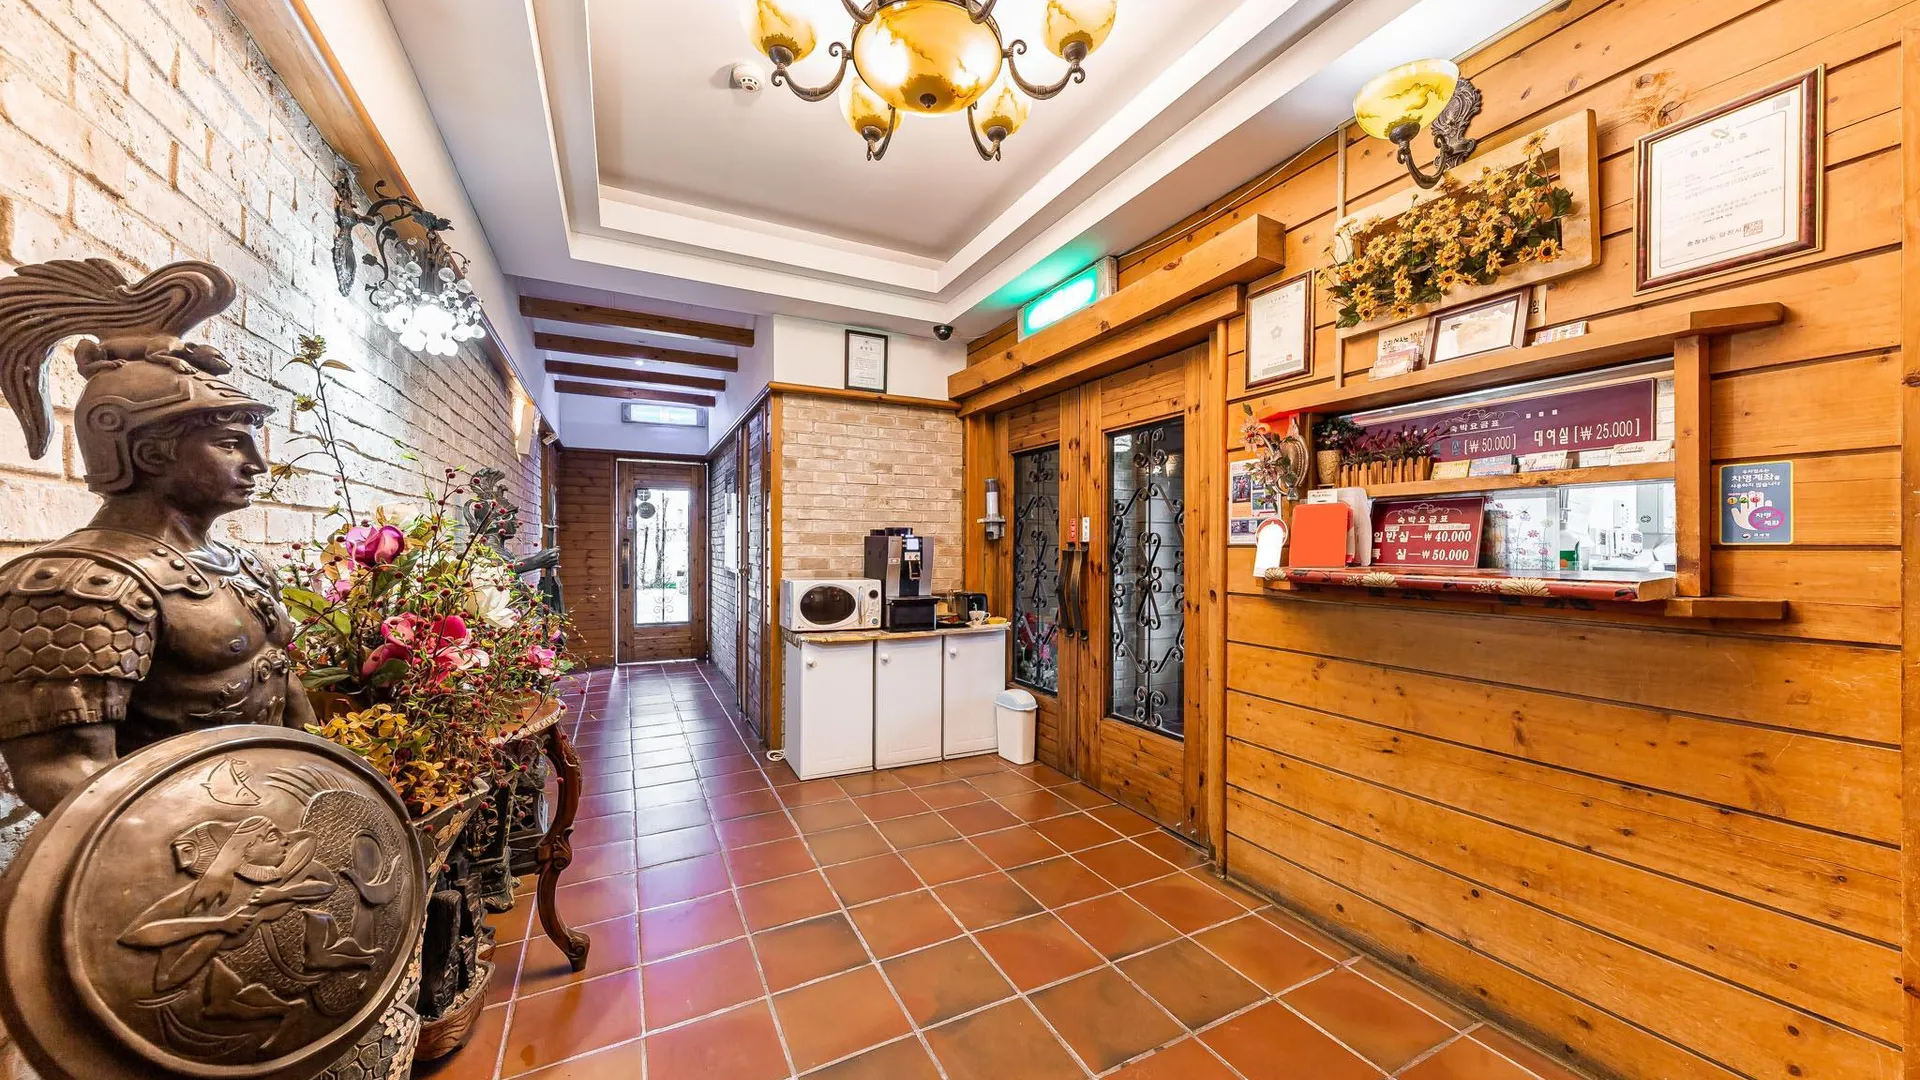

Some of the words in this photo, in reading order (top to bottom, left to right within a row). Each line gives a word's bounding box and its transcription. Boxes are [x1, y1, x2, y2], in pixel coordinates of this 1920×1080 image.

[1450, 420, 1500, 432] 숙박요금표
[1534, 427, 1569, 447] 대여실
[1397, 515, 1448, 524] 숙박요금표
